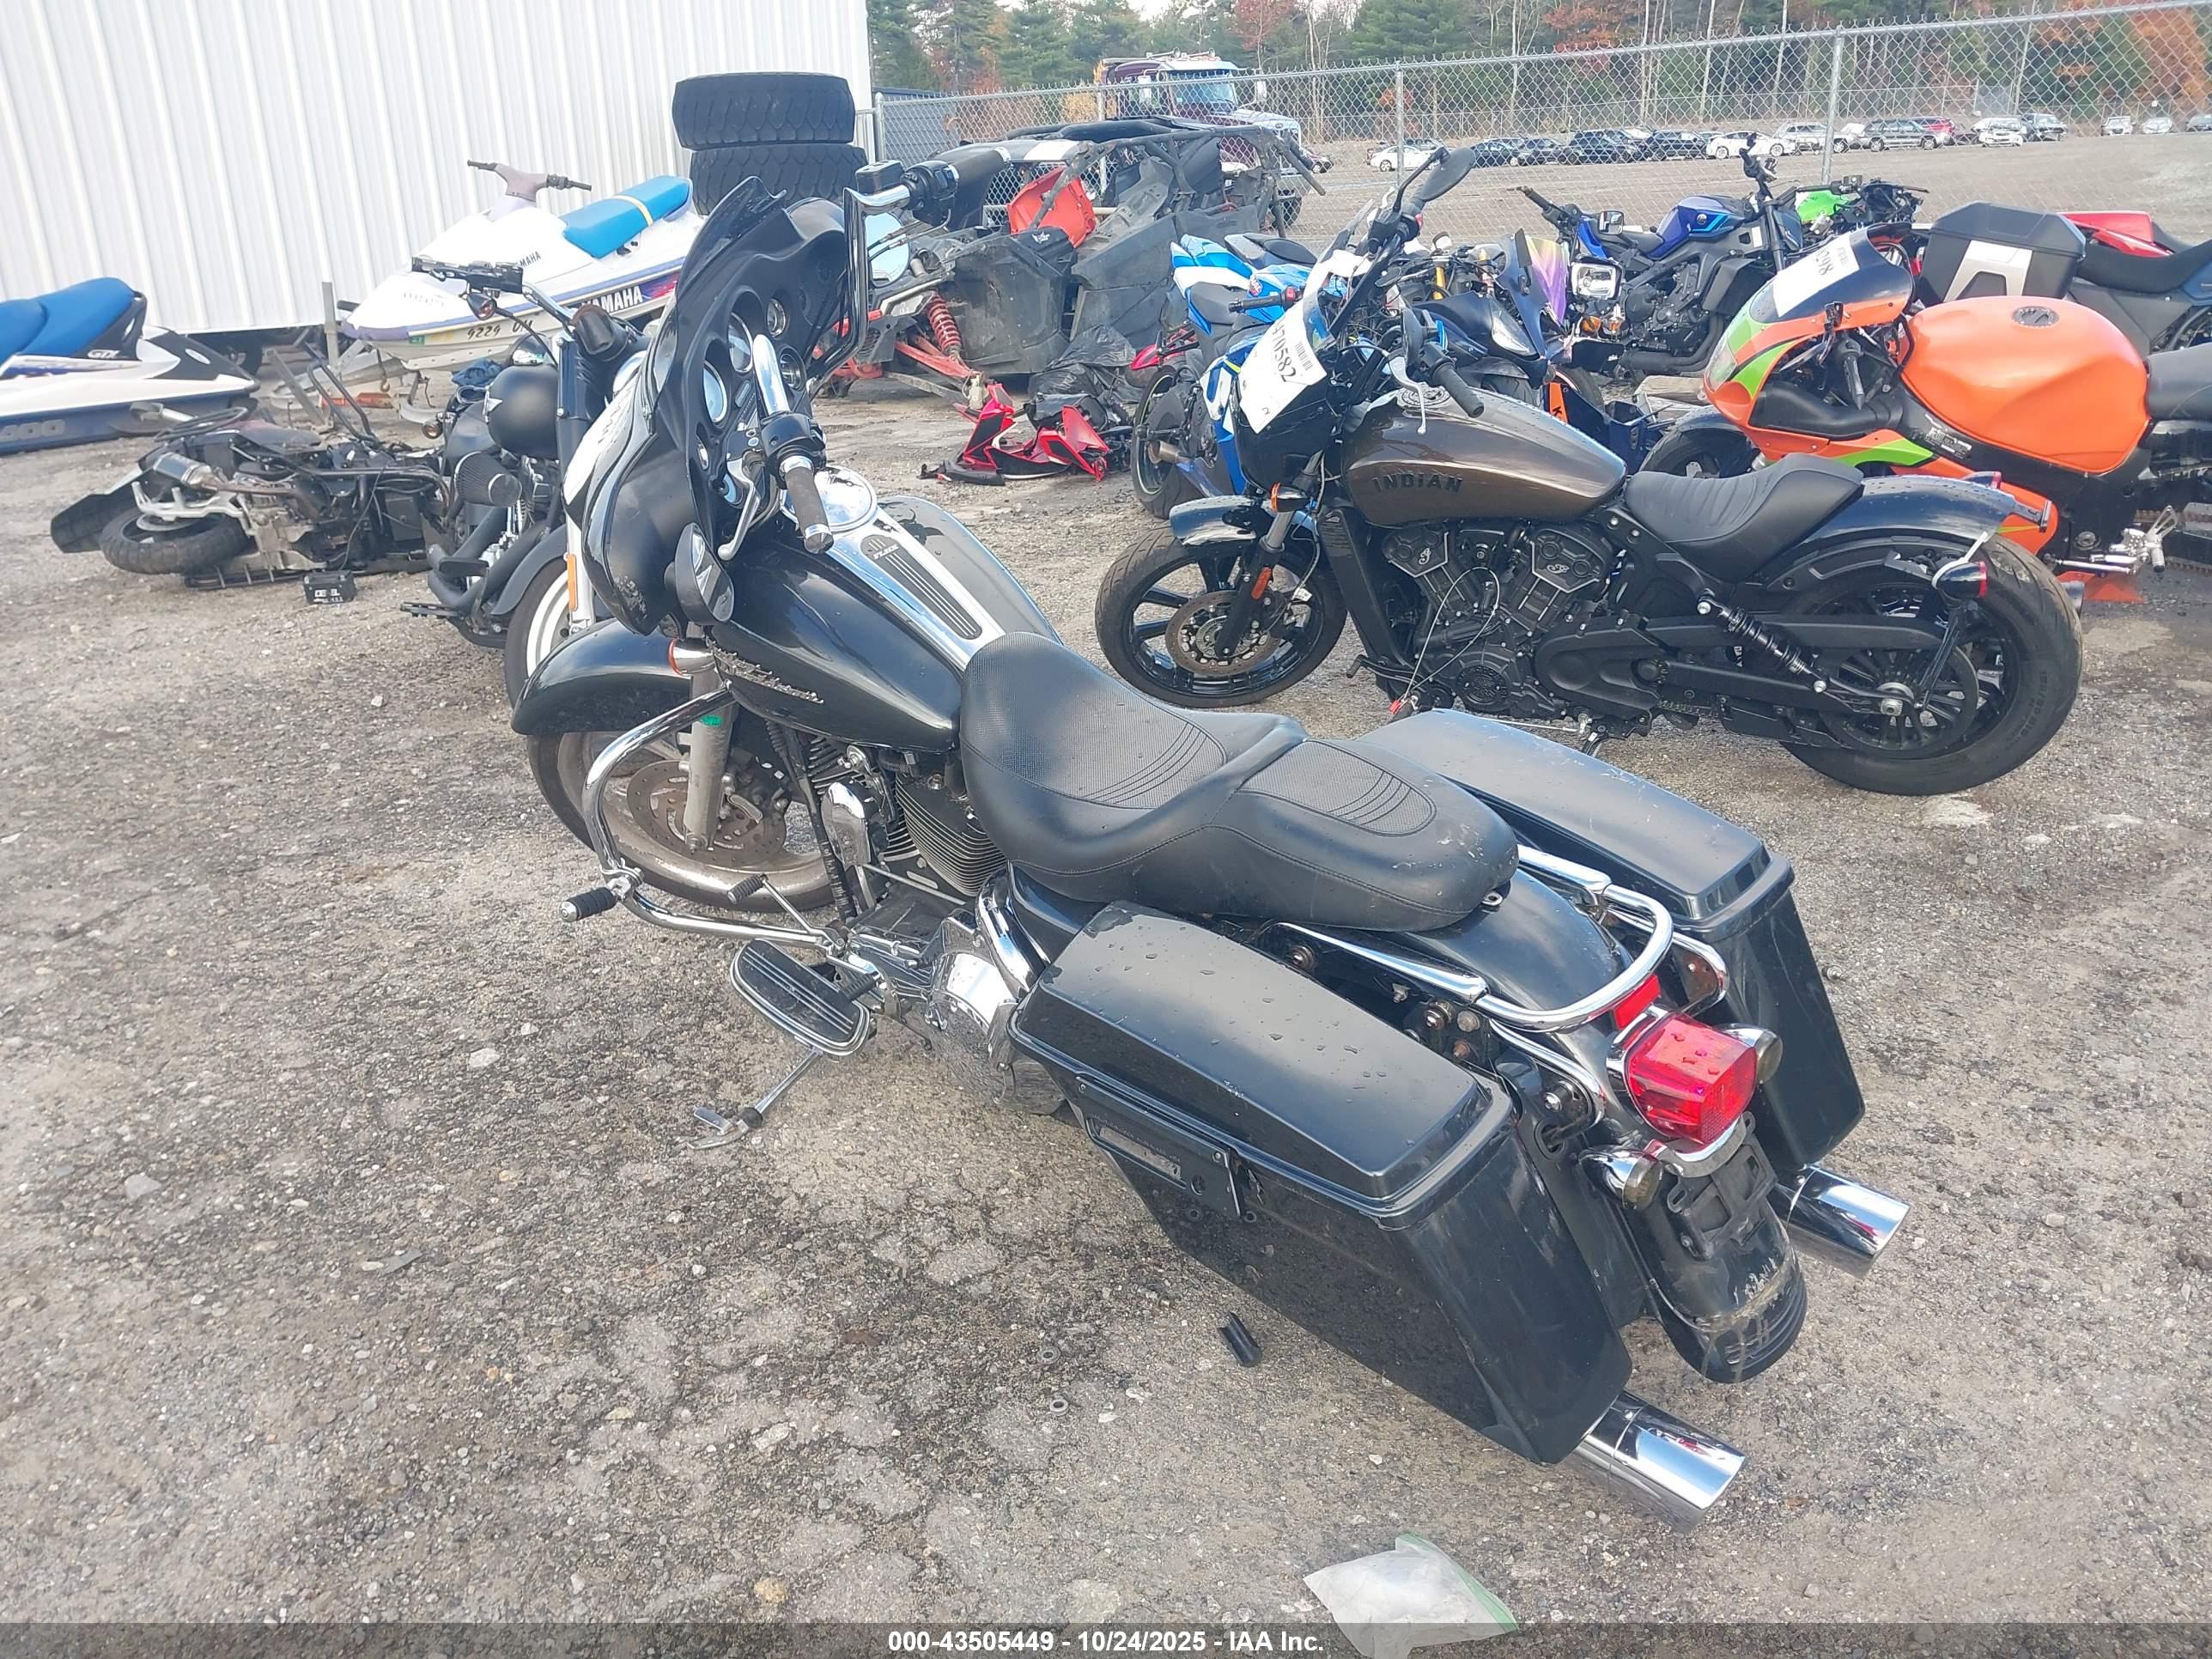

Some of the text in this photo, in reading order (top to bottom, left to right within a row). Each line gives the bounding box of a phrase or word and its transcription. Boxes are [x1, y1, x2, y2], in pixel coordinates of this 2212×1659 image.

[1814, 246, 1834, 276] 298
[581, 285, 643, 314] MAHA
[467, 324, 501, 341] 9229
[1271, 317, 1297, 384] 470582
[1371, 471, 1463, 493] INDIAN
